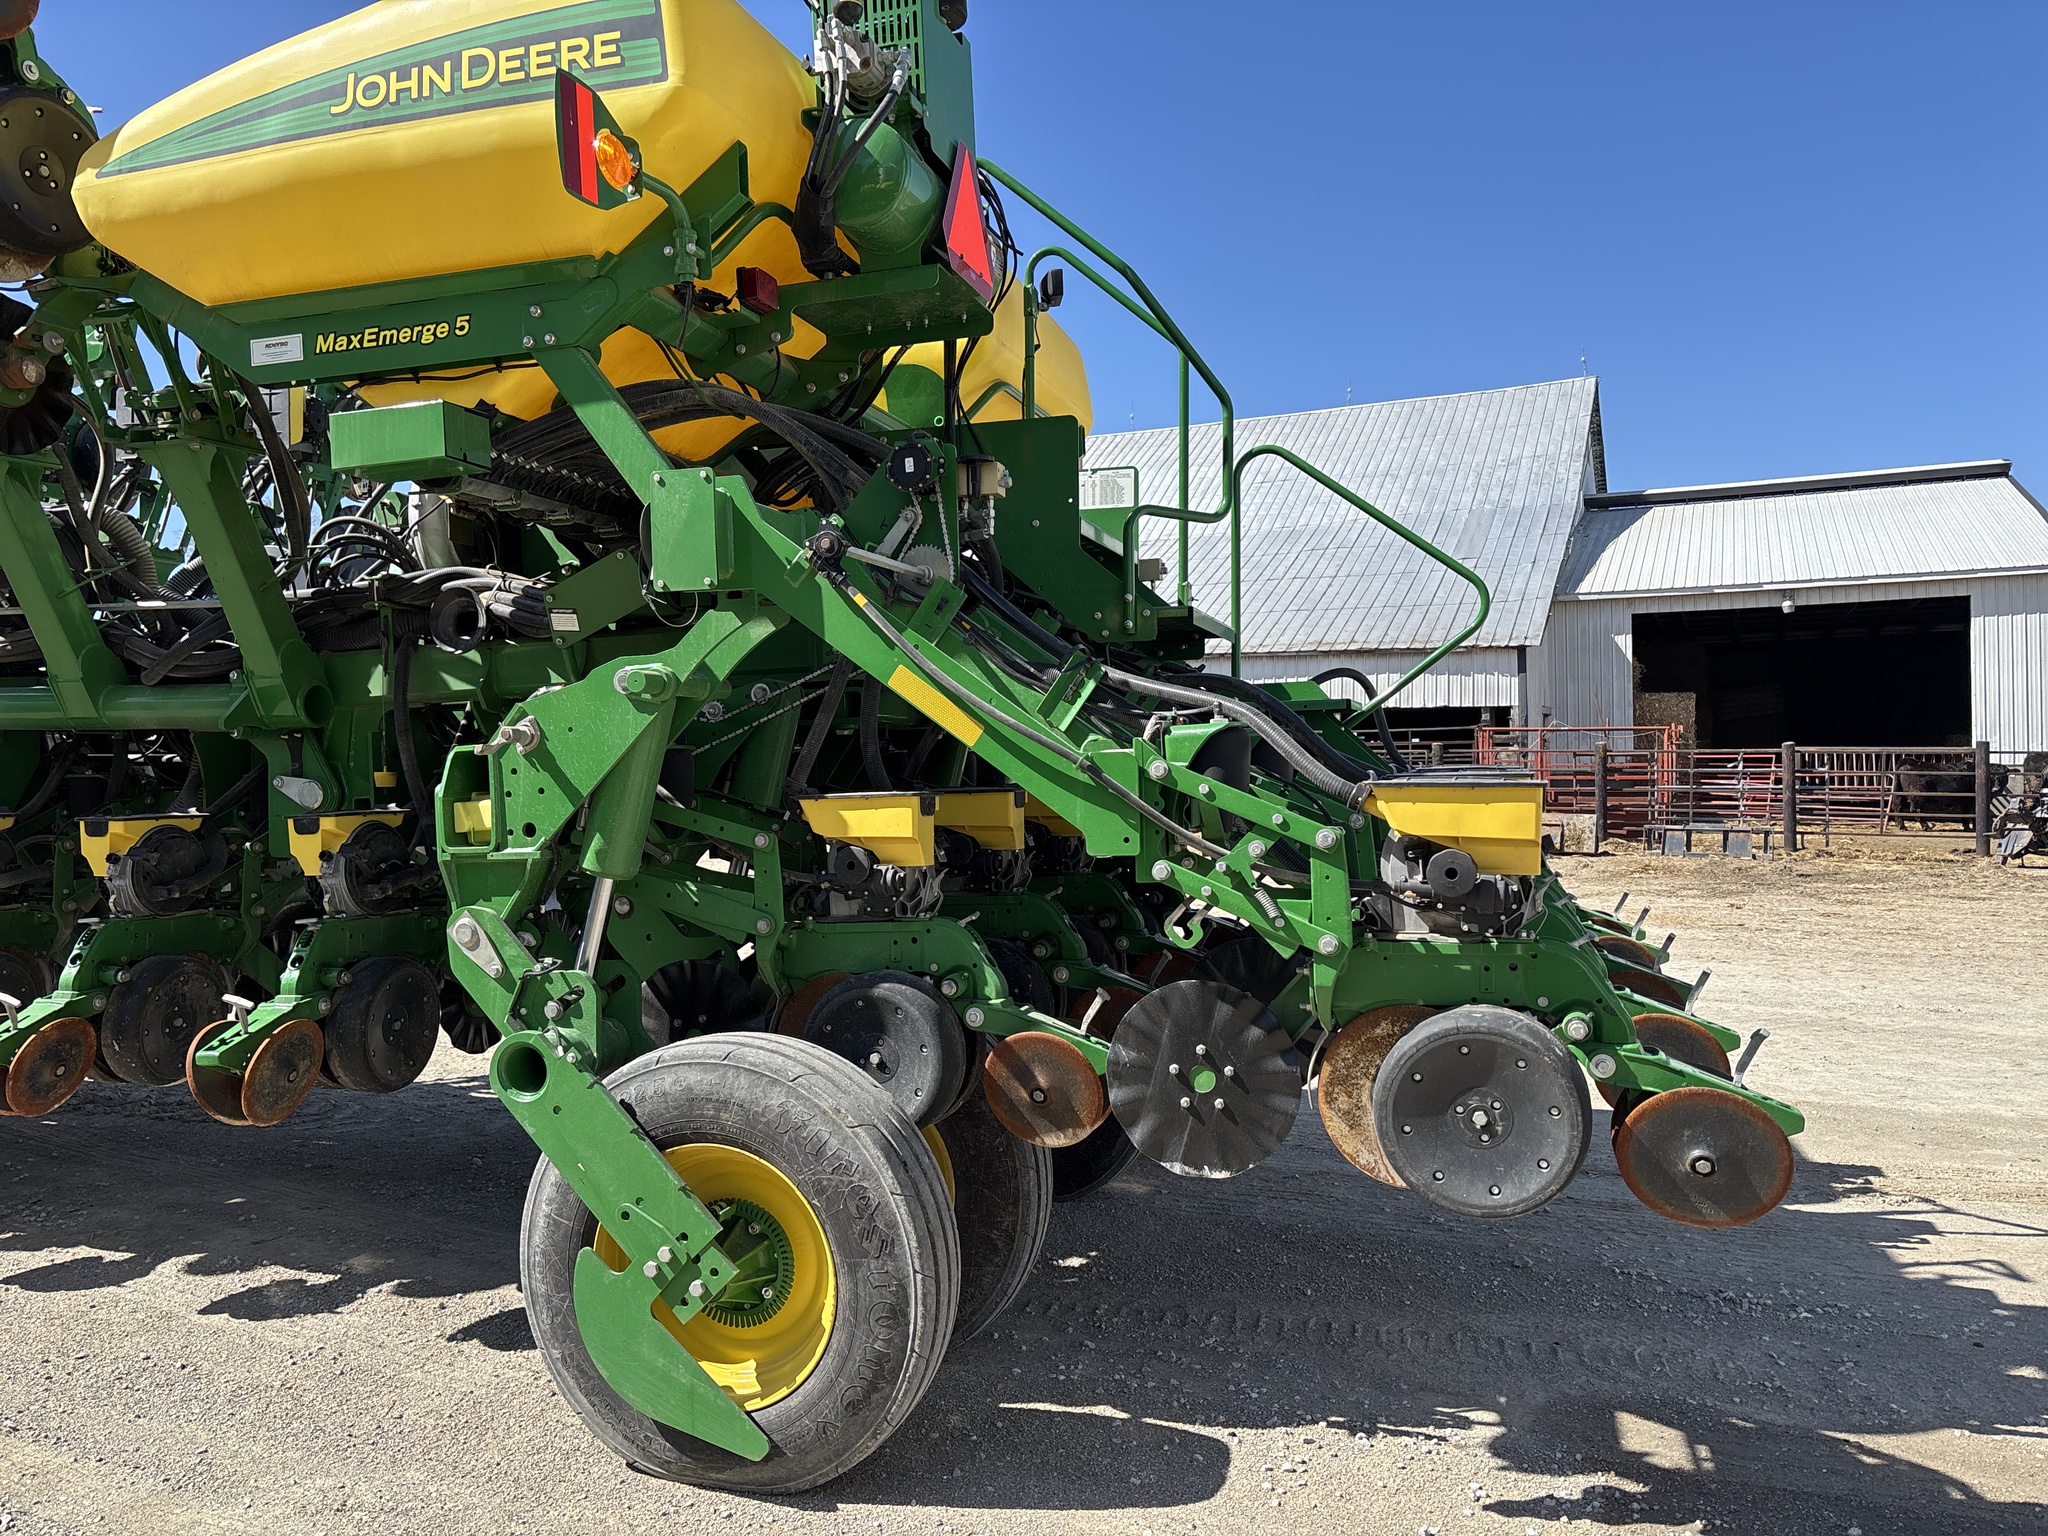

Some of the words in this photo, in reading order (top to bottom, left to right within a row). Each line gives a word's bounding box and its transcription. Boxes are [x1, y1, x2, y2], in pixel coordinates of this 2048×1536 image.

[329, 60, 453, 116] JOHN
[460, 31, 624, 91] DEERE
[314, 321, 450, 355] MaxEmerge
[453, 314, 471, 337] 5
[775, 1100, 900, 1413] Firestone
